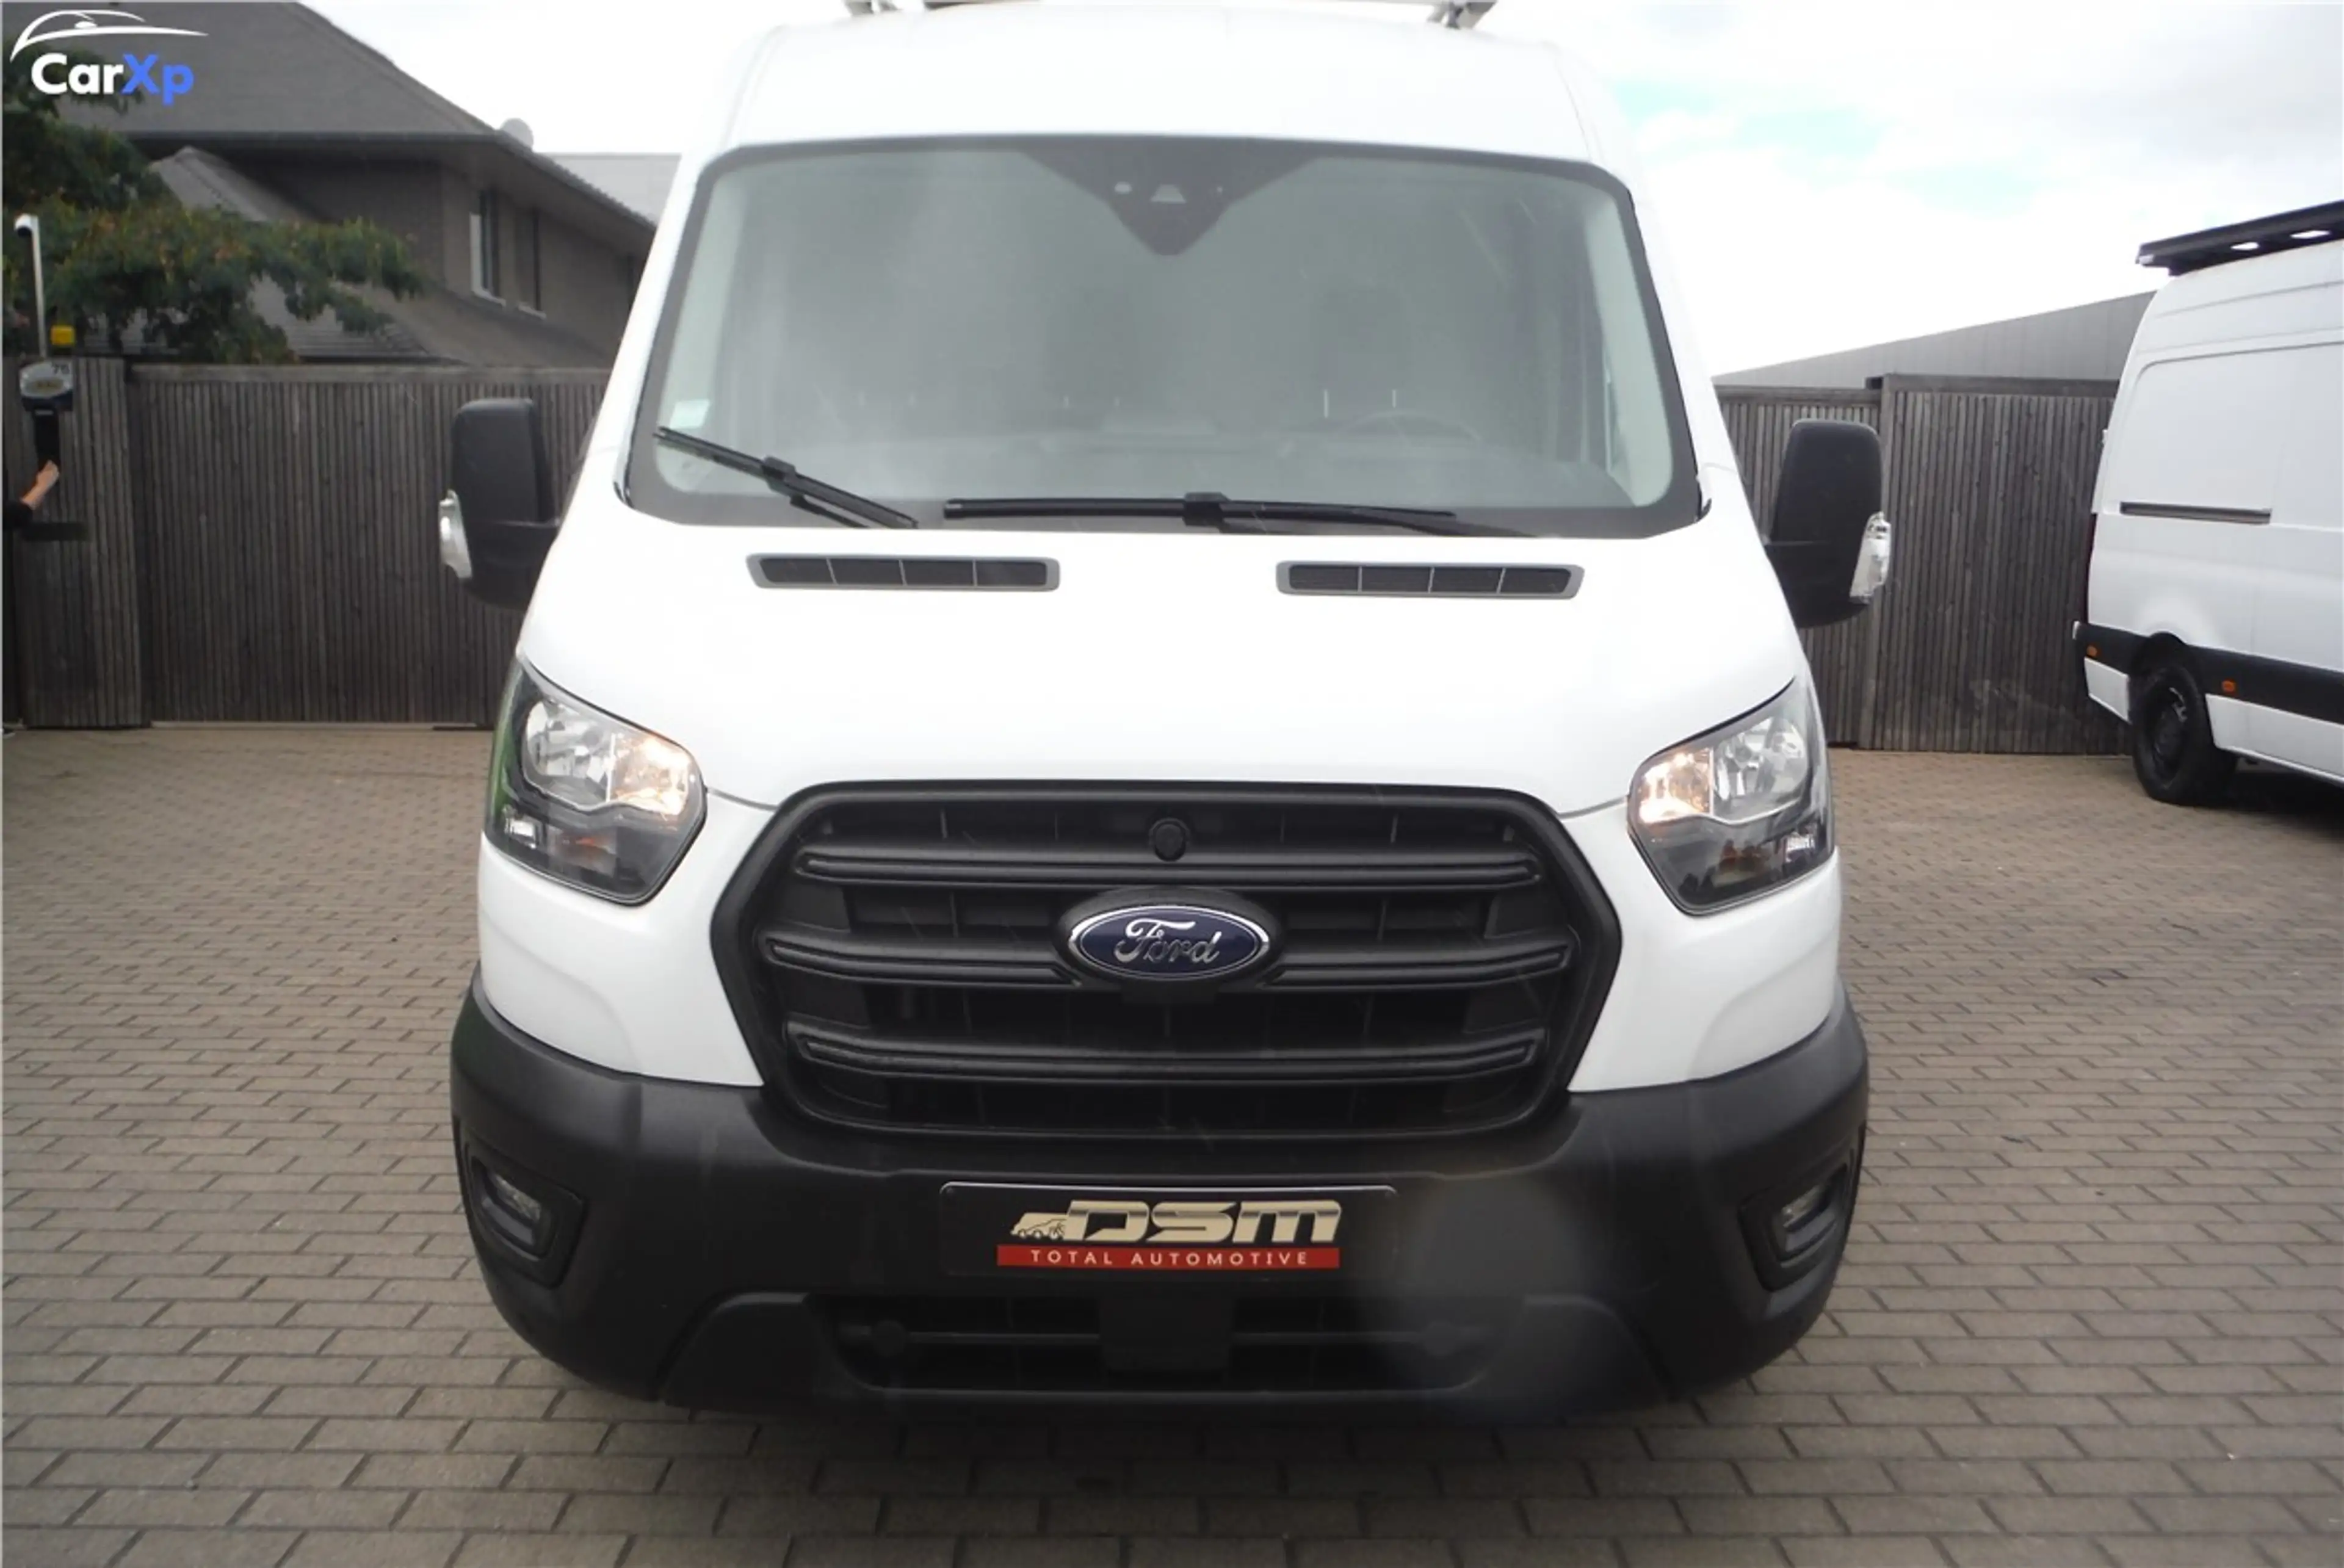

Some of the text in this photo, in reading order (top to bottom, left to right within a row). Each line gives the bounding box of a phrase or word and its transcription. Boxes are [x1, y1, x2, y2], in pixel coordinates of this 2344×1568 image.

[1113, 918, 1222, 963] Ford
[1063, 1200, 1341, 1243] DSM
[1031, 1250, 1307, 1266] TOTAL AUTOMOTIVE
